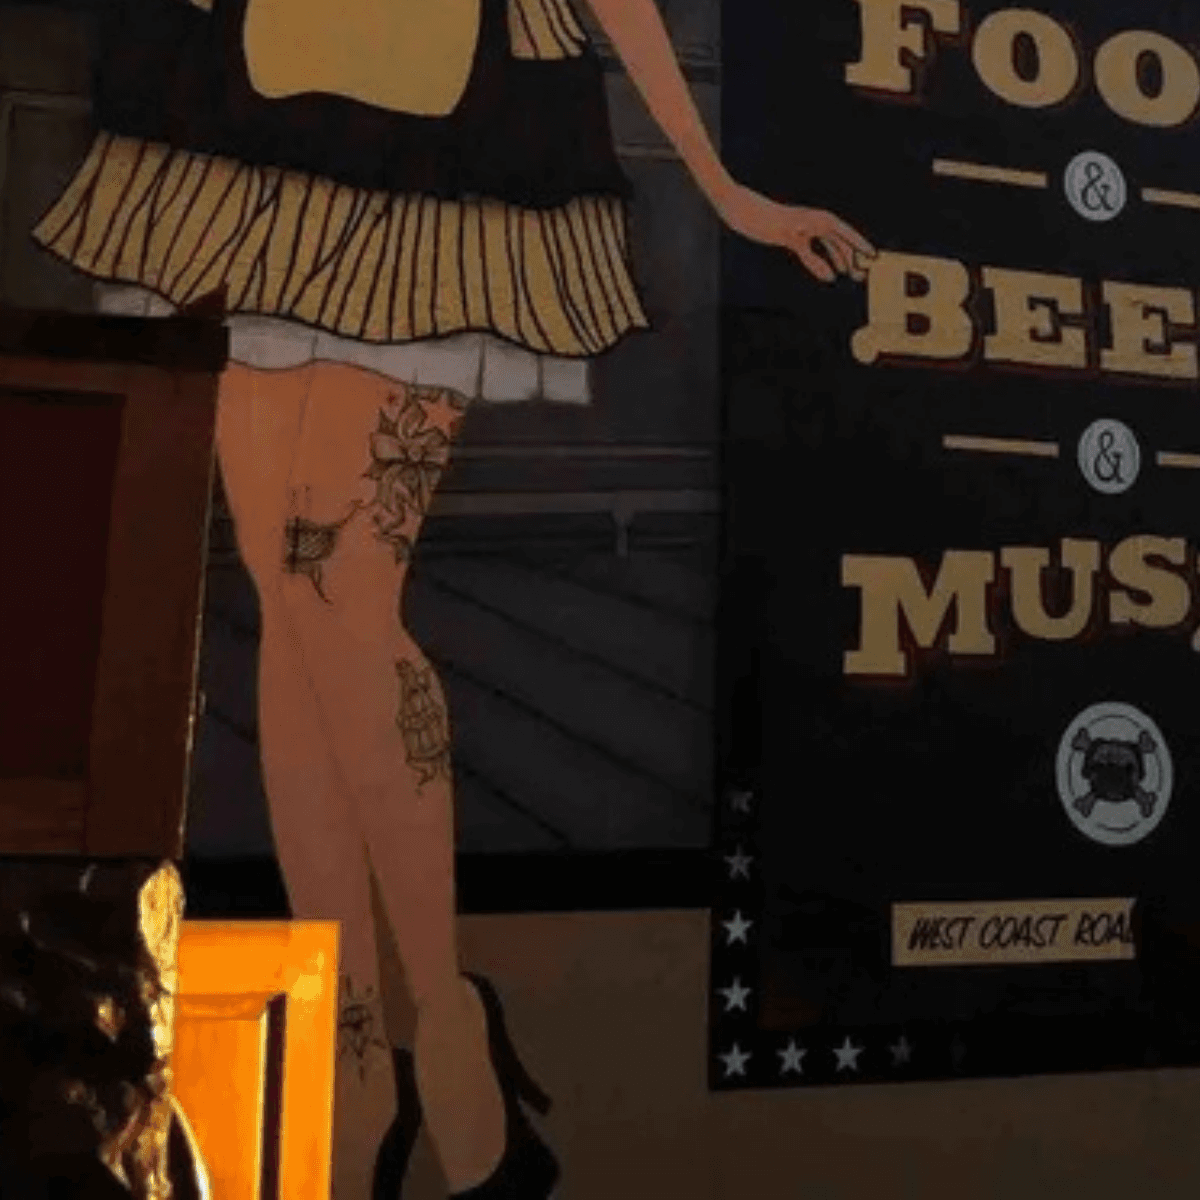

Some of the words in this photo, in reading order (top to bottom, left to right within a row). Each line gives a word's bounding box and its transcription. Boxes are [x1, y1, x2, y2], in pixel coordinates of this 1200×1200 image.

[1081, 161, 1115, 211] &
[1094, 430, 1127, 484] &
[907, 915, 973, 950] WEST
[978, 913, 1069, 949] COAST
[1074, 910, 1134, 947] ROA
